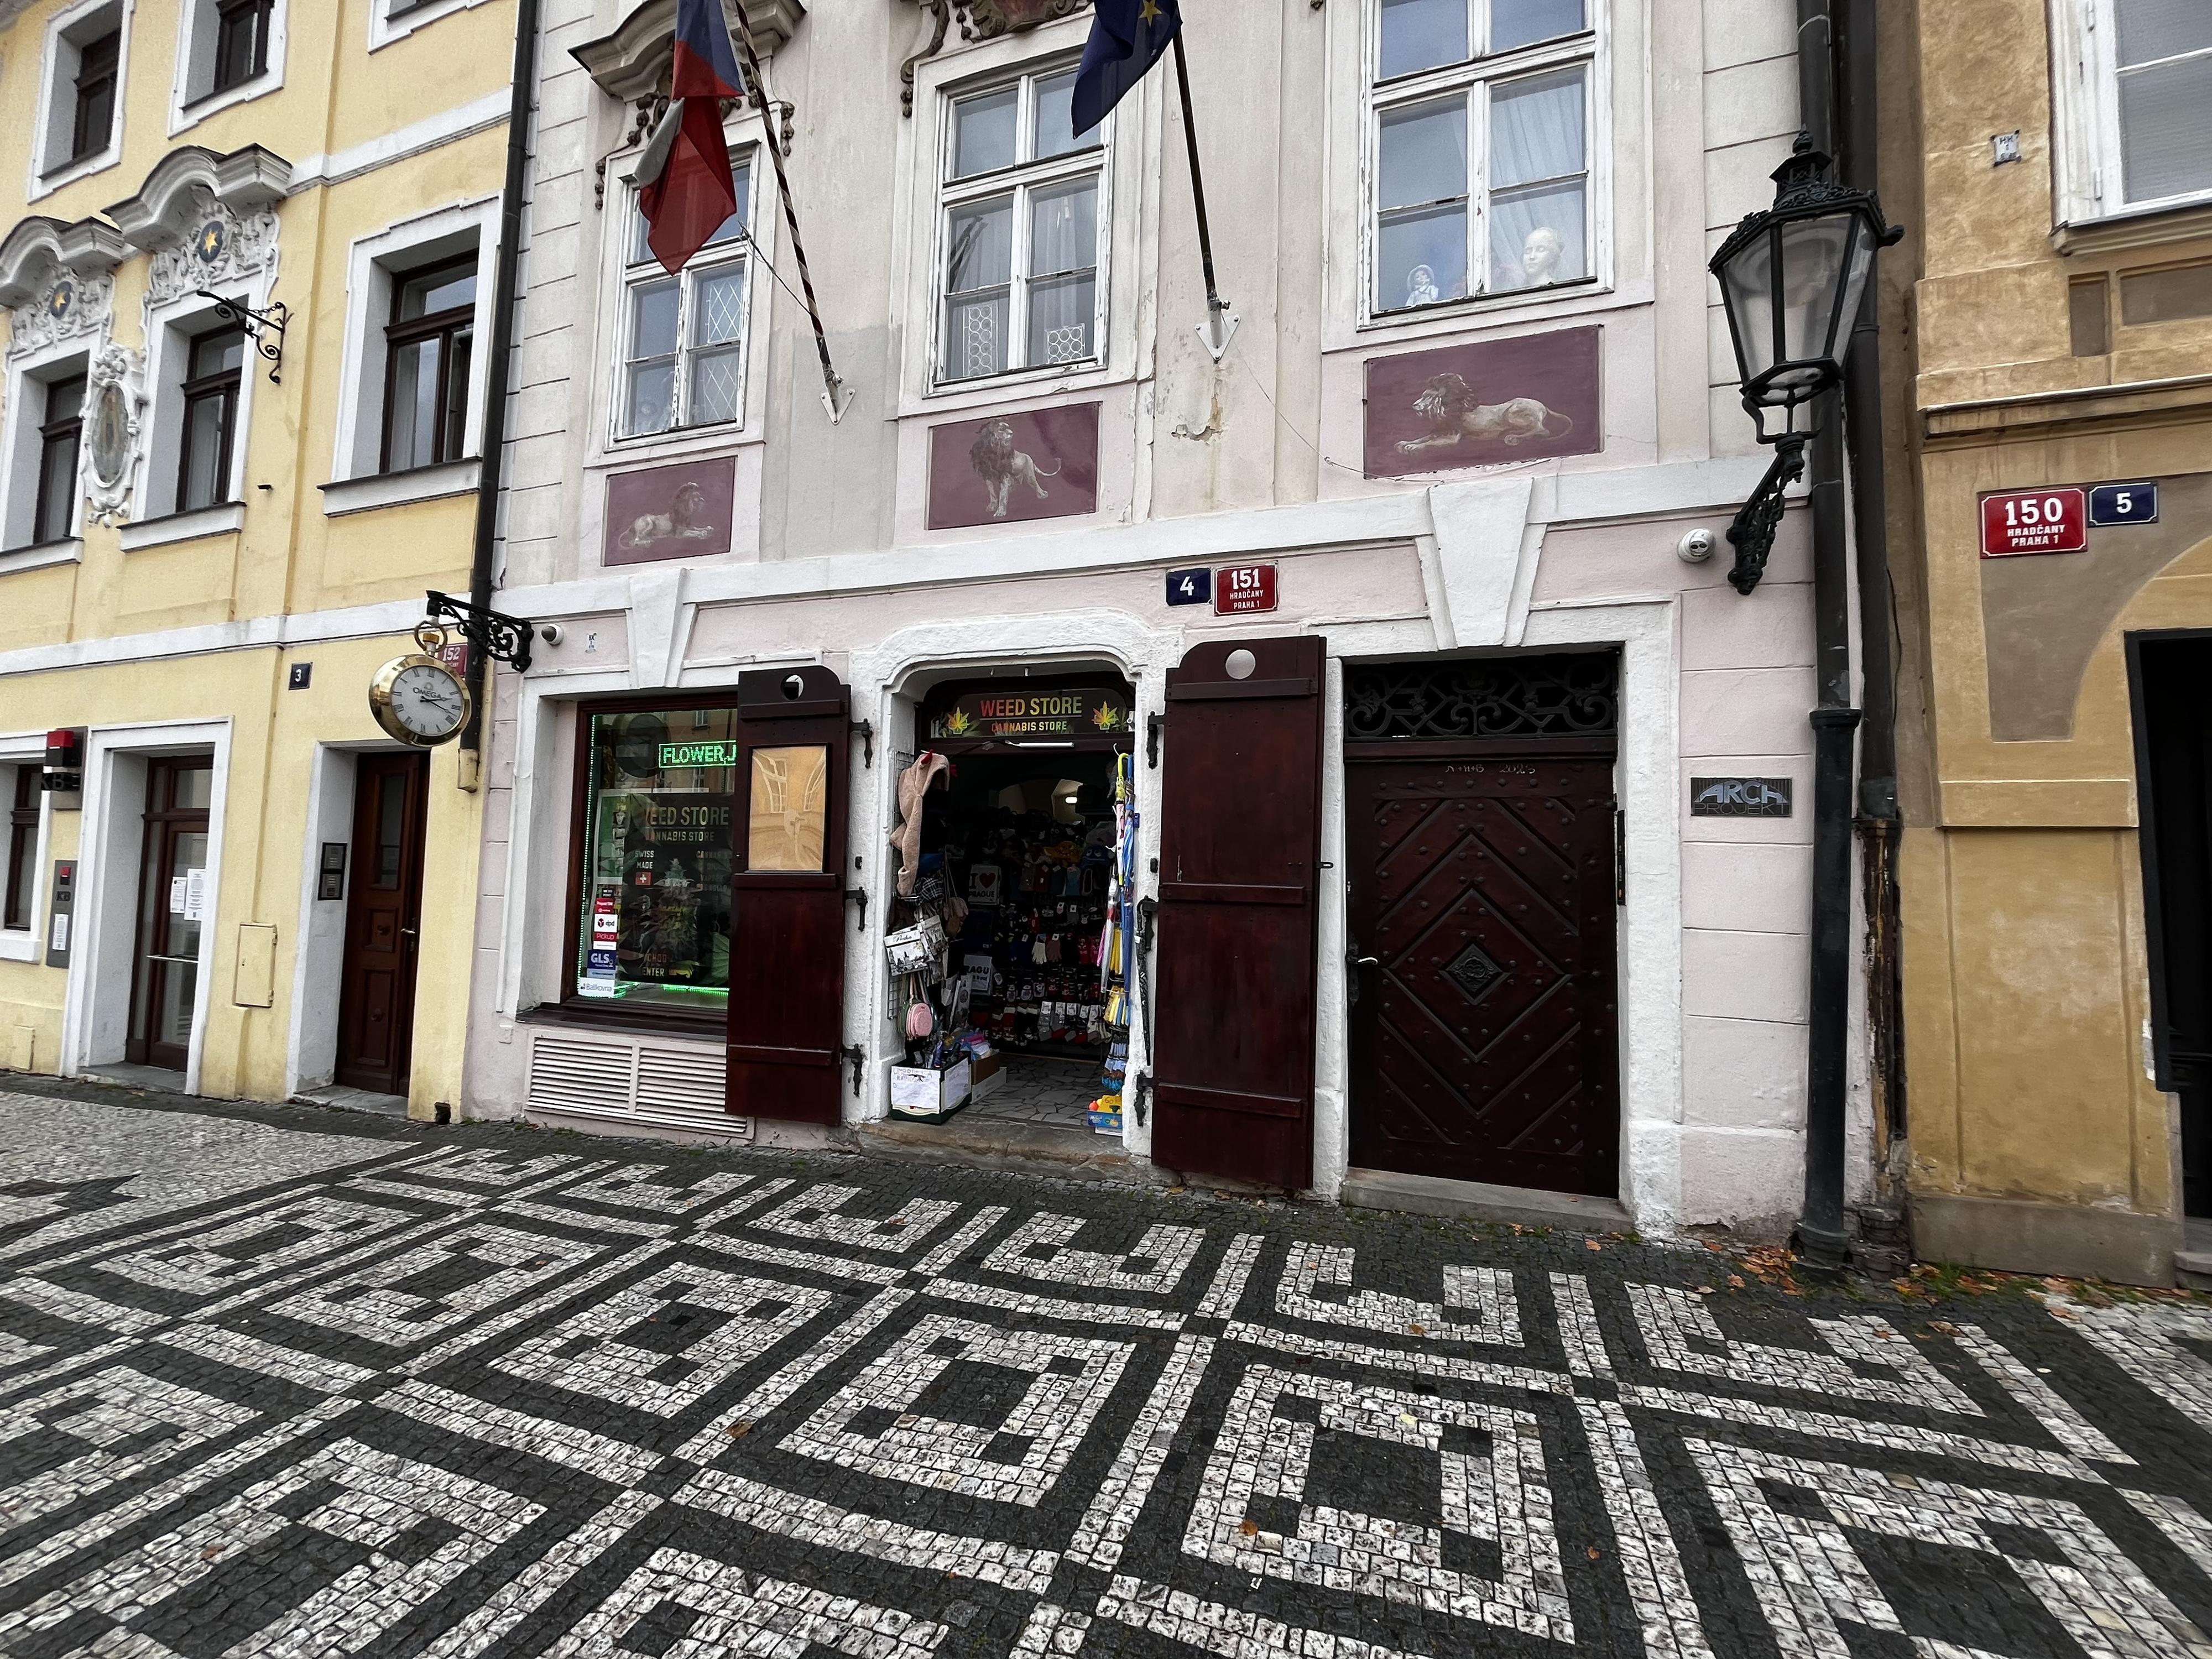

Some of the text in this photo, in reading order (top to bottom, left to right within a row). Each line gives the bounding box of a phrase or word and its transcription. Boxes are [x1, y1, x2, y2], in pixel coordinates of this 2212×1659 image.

[2116, 492, 2132, 513] 5
[2005, 497, 2063, 526] 150
[2007, 524, 2065, 537] HRADČANY
[2011, 535, 2059, 547] PRAHA 1
[1231, 568, 1260, 589] 151
[1180, 576, 1194, 596] 4
[1229, 589, 1264, 600] HRADČANY
[1233, 601, 1254, 609] PRAHA
[442, 646, 460, 661] 152
[295, 669, 301, 682] 3
[413, 687, 442, 698] OMEGA
[980, 696, 1082, 717] WEED STORE
[992, 721, 1067, 733] CANNABIS STORE
[1694, 780, 1788, 804] ARCH
[1693, 803, 1786, 815] PROJEKT
[680, 806, 729, 826] STORE
[688, 831, 715, 842] STORE
[591, 953, 609, 963] GLS
[643, 967, 665, 977] ENTER
